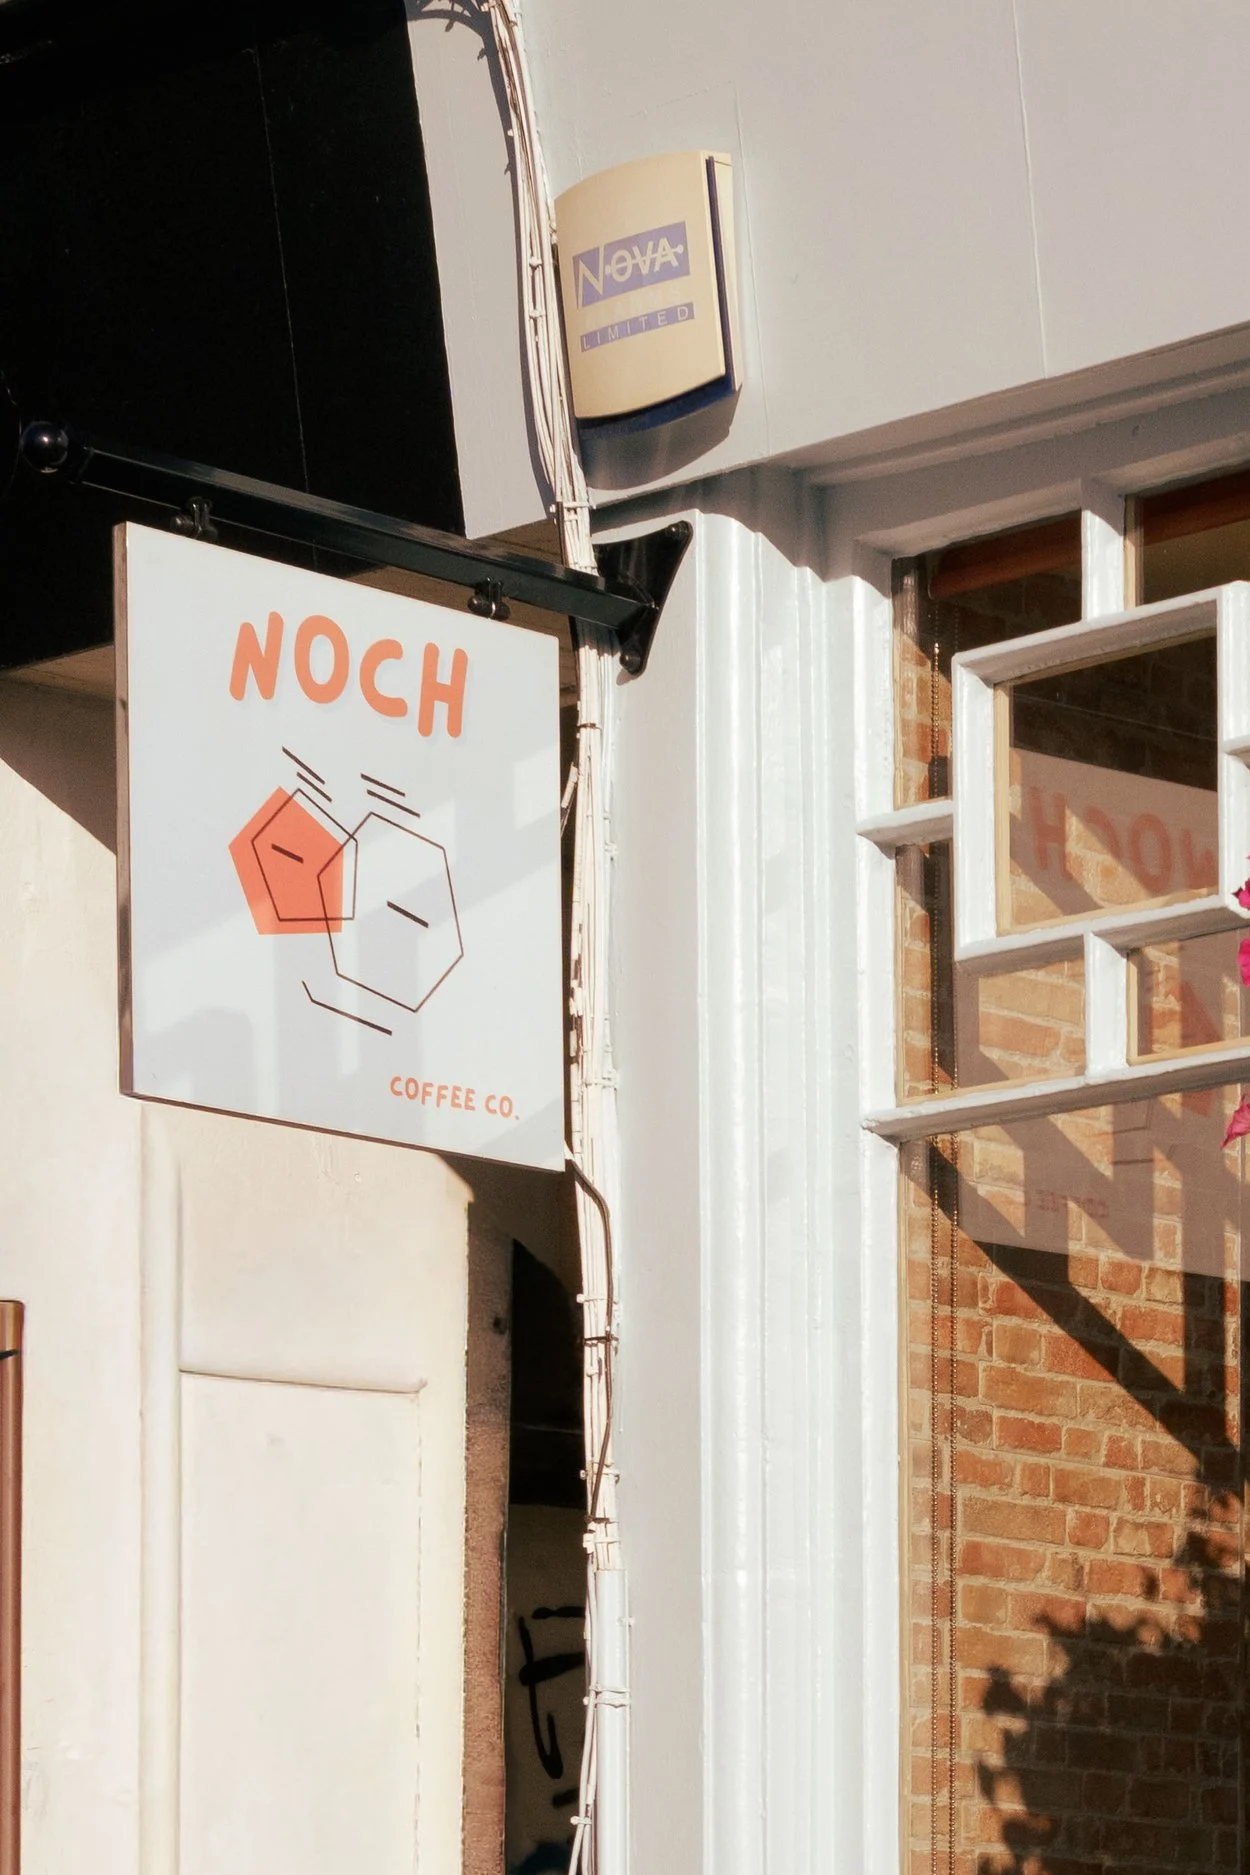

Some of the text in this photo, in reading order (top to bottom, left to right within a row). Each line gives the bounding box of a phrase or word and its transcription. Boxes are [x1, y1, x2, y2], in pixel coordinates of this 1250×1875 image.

[575, 236, 684, 311] NOVA
[582, 306, 690, 350] LIMITED
[229, 611, 468, 738] NOCH
[390, 1076, 520, 1121] COFFEE CO.
